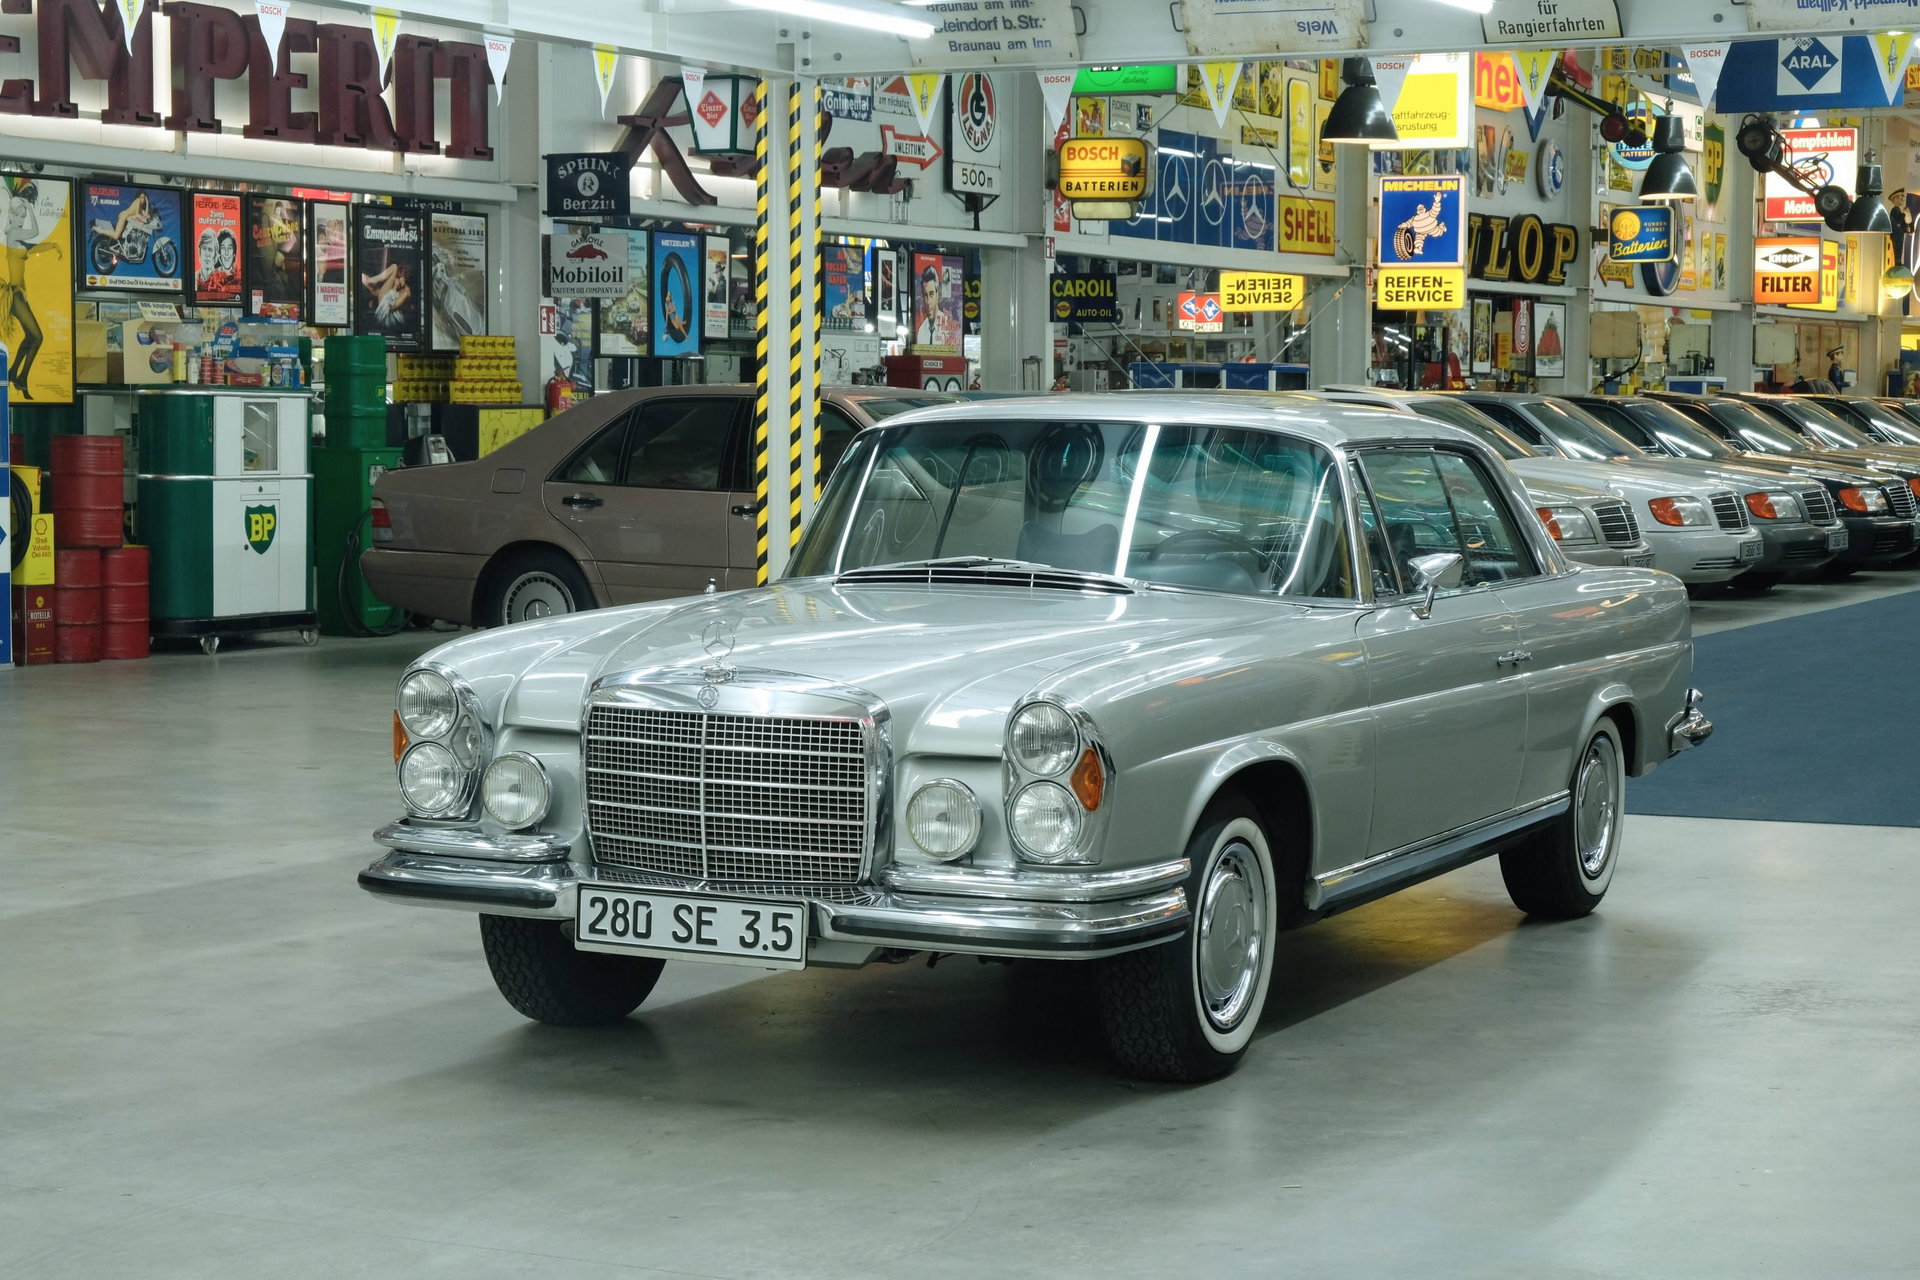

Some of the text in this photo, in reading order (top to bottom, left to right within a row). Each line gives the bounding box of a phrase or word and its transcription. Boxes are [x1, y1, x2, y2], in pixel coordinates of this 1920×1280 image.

[260, 4, 282, 16] BOSCH
[1537, 0, 1558, 15] für
[1297, 20, 1338, 36] Wels
[1498, 17, 1605, 38] Rangierfahrten
[488, 41, 507, 52] BOSCH
[949, 38, 1052, 52] Braunau am Inn
[1690, 49, 1721, 58] BOSCH
[1376, 62, 1405, 70] BOSCH
[1788, 55, 1832, 69] ARAL
[685, 73, 701, 82] BOSCH
[1044, 76, 1071, 84] BOSCH
[701, 104, 723, 112] Linzer
[706, 112, 719, 120] Bier
[1392, 110, 1451, 121] raftfahrzeug-
[1792, 132, 1852, 150] empfehlen
[894, 142, 926, 156] UMLEITUNG
[1067, 147, 1119, 161] BOSCH
[1705, 139, 1723, 185] BP
[961, 168, 993, 188] 500 m
[89, 186, 119, 196] SUZUKI
[1066, 181, 1139, 192] BATTERIEN
[1384, 180, 1459, 192] MICHELIN
[1284, 206, 1331, 244] SHELL
[661, 239, 690, 248] METZELER
[1612, 237, 1669, 257] Batterien
[1768, 254, 1805, 264] KNECHT
[552, 266, 623, 283] Mobiloil
[1052, 279, 1114, 297] CAROIL
[1761, 276, 1812, 293] FILTER
[1385, 290, 1453, 302] SERVICE
[249, 513, 275, 542] BP
[588, 895, 794, 952] 280 SE 3.5
